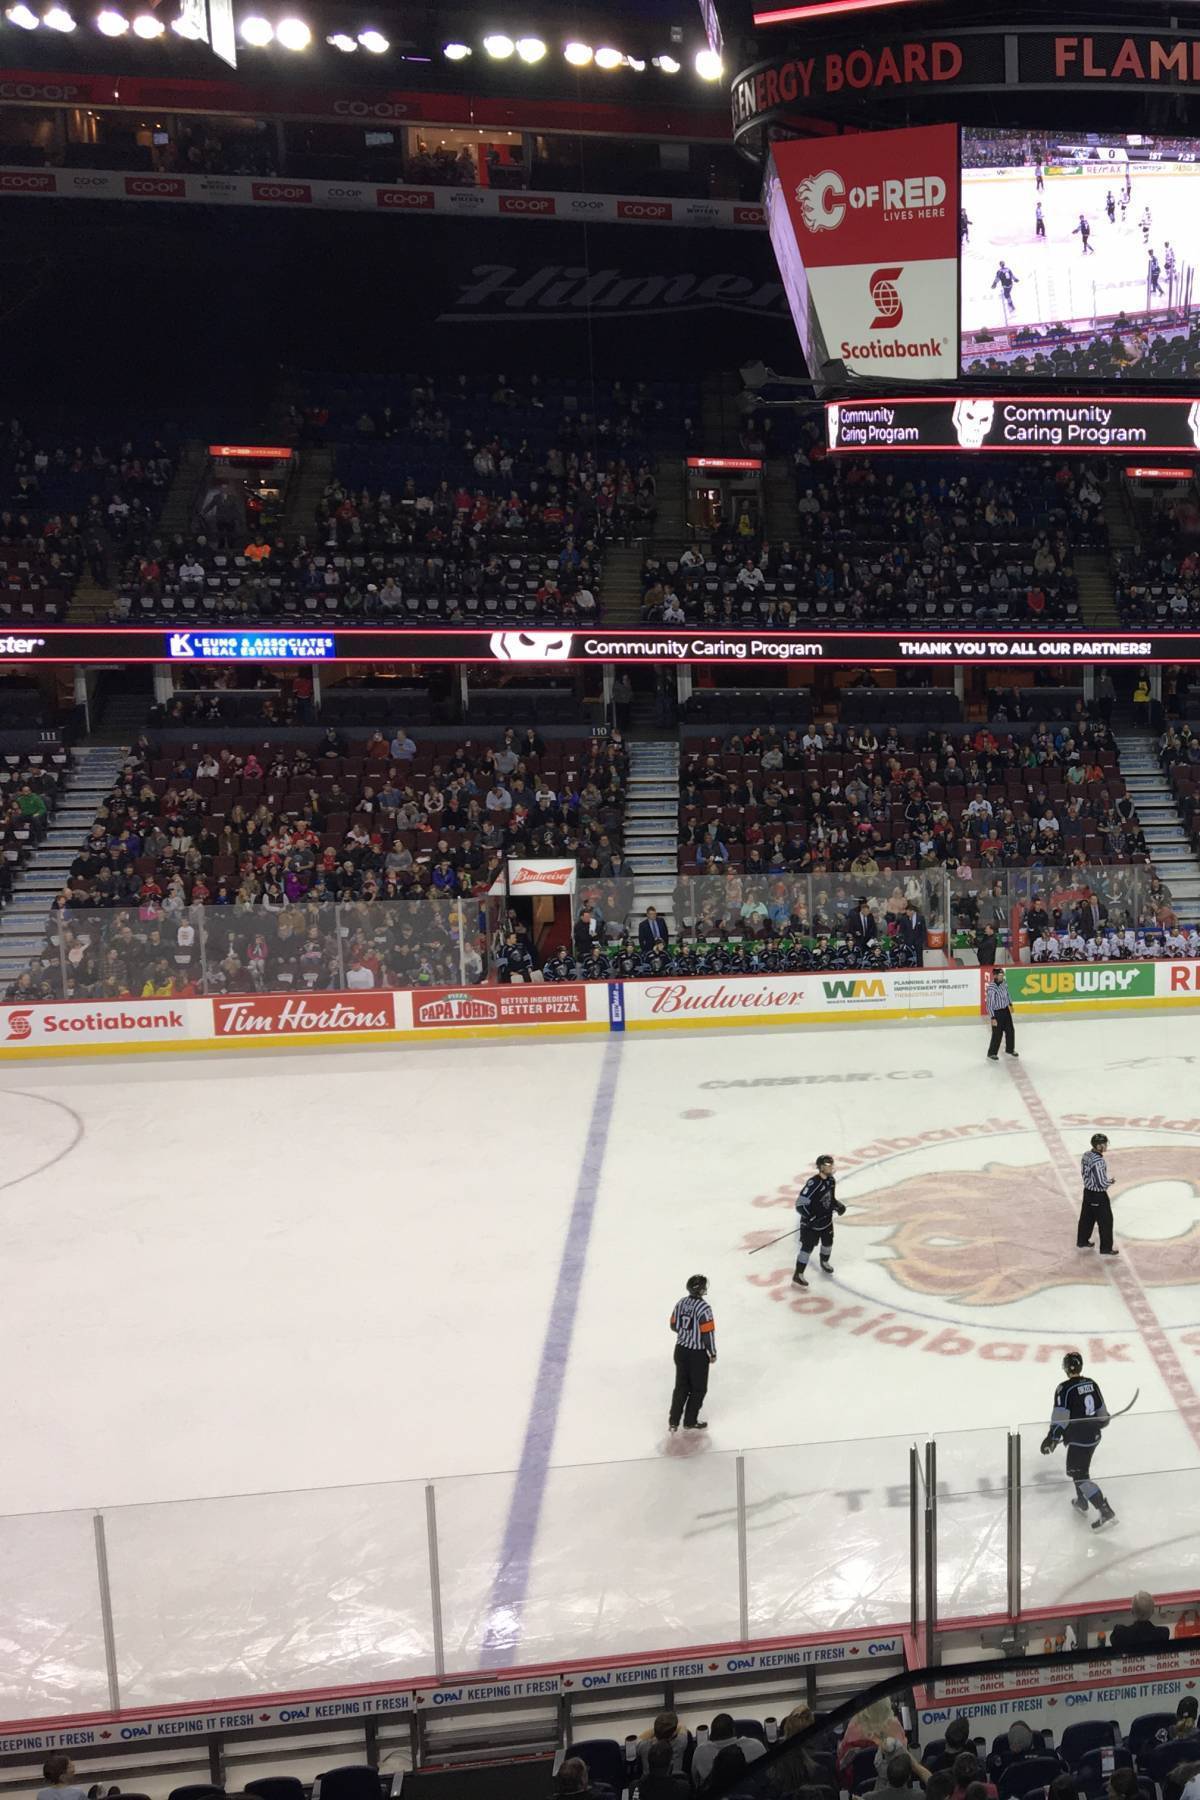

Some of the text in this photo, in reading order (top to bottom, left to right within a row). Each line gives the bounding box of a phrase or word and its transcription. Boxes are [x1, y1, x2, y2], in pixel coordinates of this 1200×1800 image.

[738, 42, 963, 121] ENERGY BOARD
[1108, 149, 1115, 158] 0
[1148, 152, 1163, 160] 1ST
[848, 186, 881, 209] OF
[882, 176, 947, 211] RED
[883, 208, 946, 222] LIVES HERE
[841, 337, 943, 361] Scotiabank
[840, 406, 895, 426] Community
[1003, 405, 1112, 425] Community
[840, 425, 919, 444] Caring Program
[1003, 425, 1147, 444] Caring Program
[194, 638, 333, 647] LEUNG & ASSOCIATES
[203, 647, 325, 656] REAL ESTATE TEAM
[584, 639, 822, 658] Community Caring Program
[899, 642, 1152, 655] THANK YOU TO ALL OUR PARTNERS!
[40, 731, 57, 741] 111
[592, 727, 607, 736] 110
[514, 868, 570, 882] Budweiser
[822, 979, 888, 999] WM
[1021, 966, 1141, 996] SUBWAY
[500, 996, 533, 1005] BETTER
[500, 1002, 581, 1017] BETTER PIZZA.
[644, 985, 805, 1015] Budweiser
[219, 999, 388, 1032] Tim Hortons
[420, 1000, 454, 1021] PAPA
[42, 1011, 184, 1032] Scotiabank
[697, 1069, 935, 1090] CARSTAR.ca
[279, 1697, 409, 1722] OPA! KEEPING IT FRESH
[921, 1698, 1043, 1725] OPA! KEEPING IT FRESH
